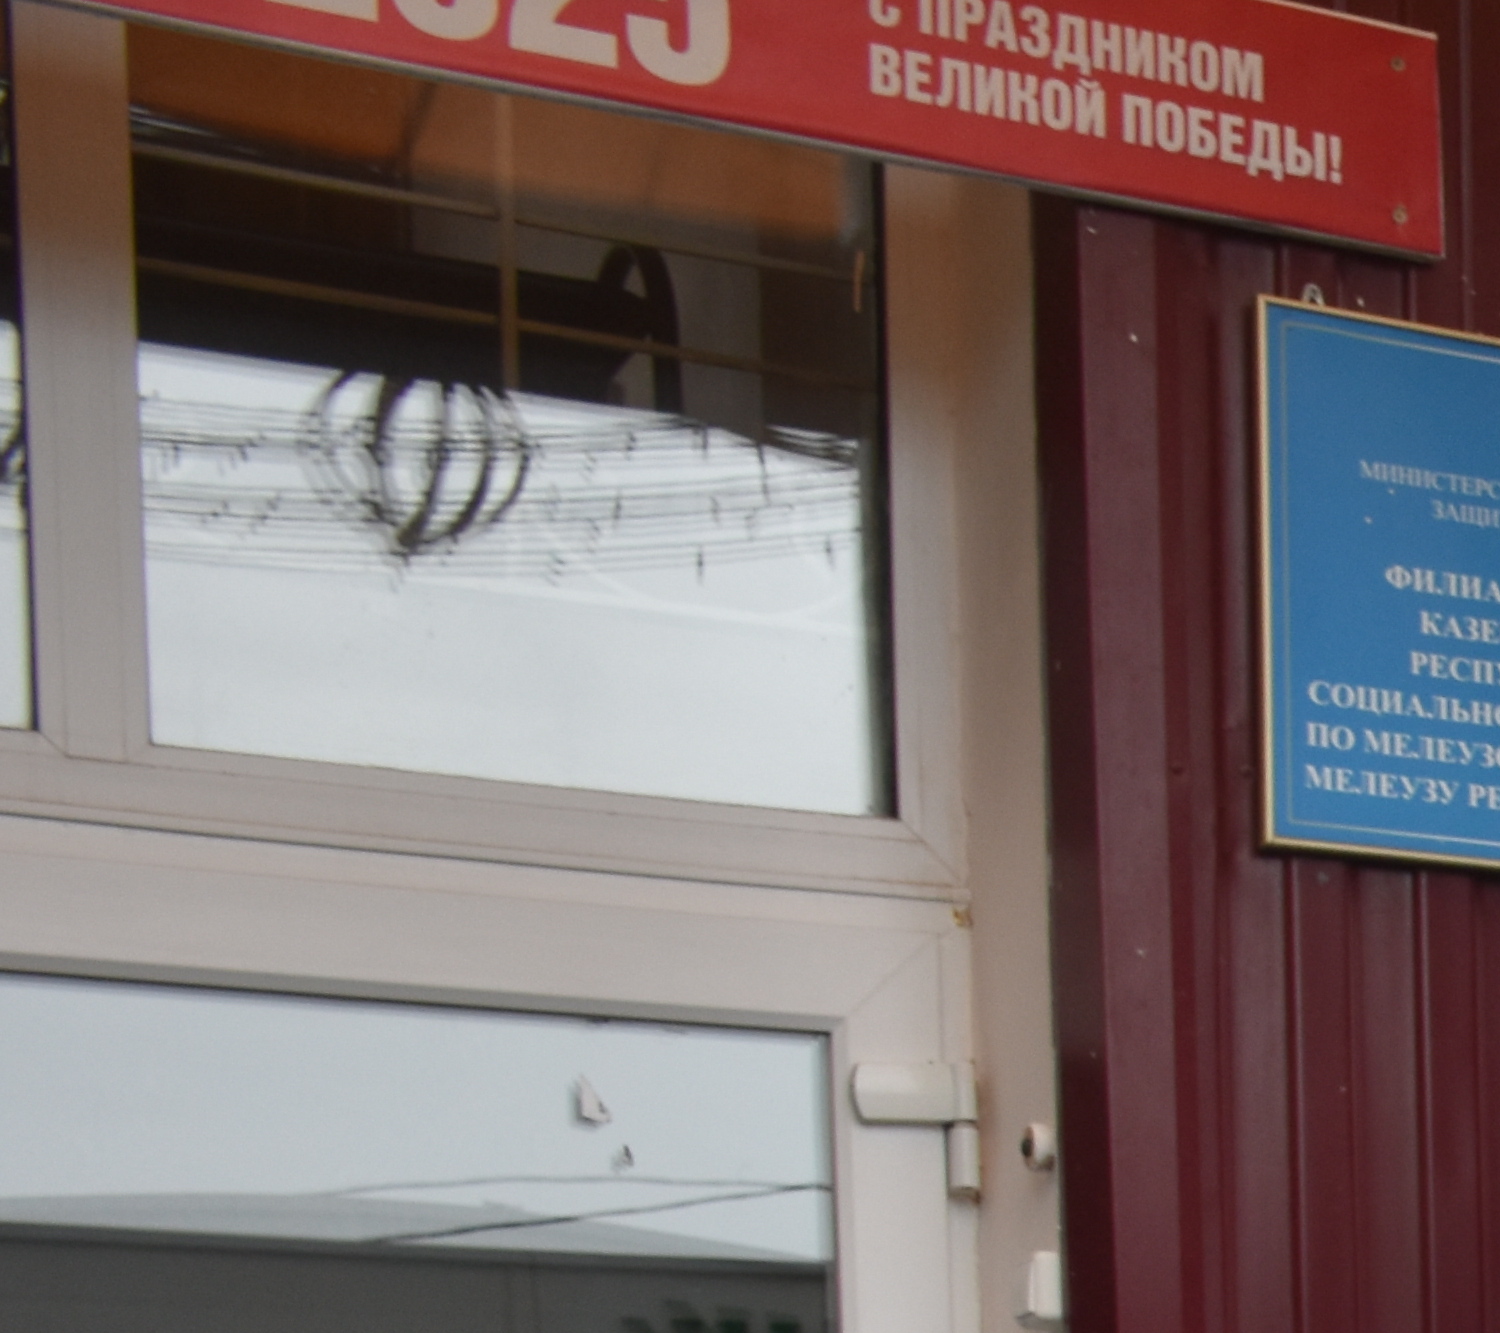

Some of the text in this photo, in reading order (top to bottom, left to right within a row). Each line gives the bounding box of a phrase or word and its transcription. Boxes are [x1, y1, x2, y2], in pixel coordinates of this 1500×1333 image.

[919, 0, 1264, 102] ПРАЗДНИКОМ
[869, 43, 1343, 184] ВЕЛИКОЙ ПОБЕДЫ!
[1306, 722, 1355, 751] ПО
[1305, 763, 1459, 805] МЕЛЕУЗУ
